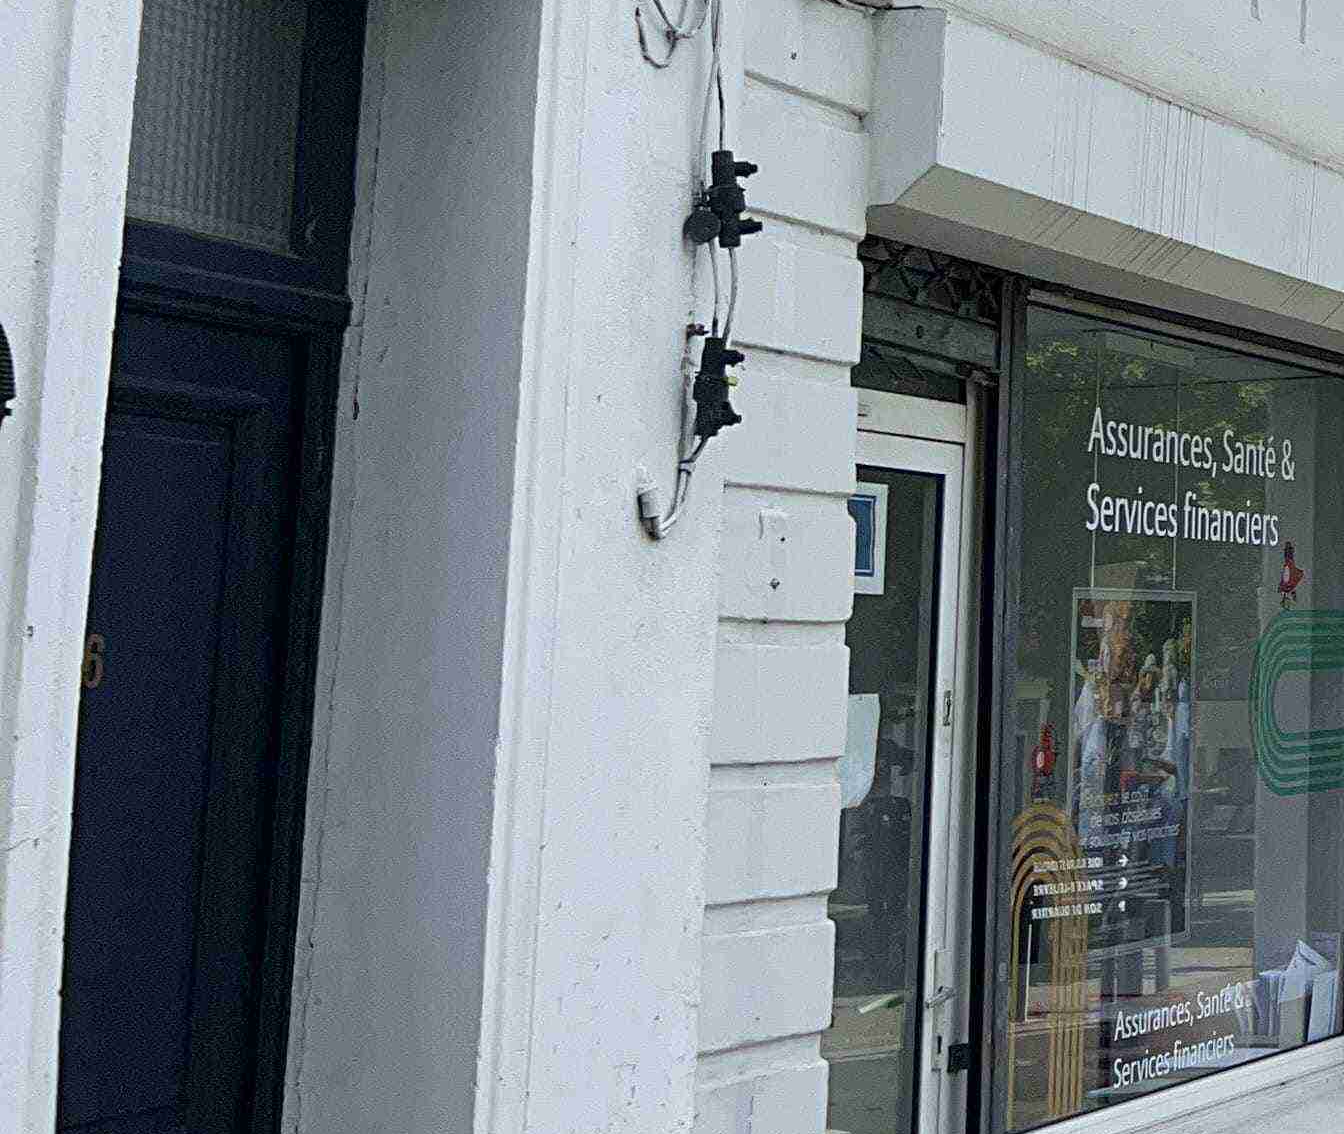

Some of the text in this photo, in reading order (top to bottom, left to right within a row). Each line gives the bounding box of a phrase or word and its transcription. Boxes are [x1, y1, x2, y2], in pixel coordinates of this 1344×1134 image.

[1087, 407, 1295, 481] Assurances, Santé &
[1085, 482, 1280, 546] Services financiers
[1114, 982, 1245, 1041] Assurances, Santé &
[1113, 1031, 1234, 1088] Services financiers
